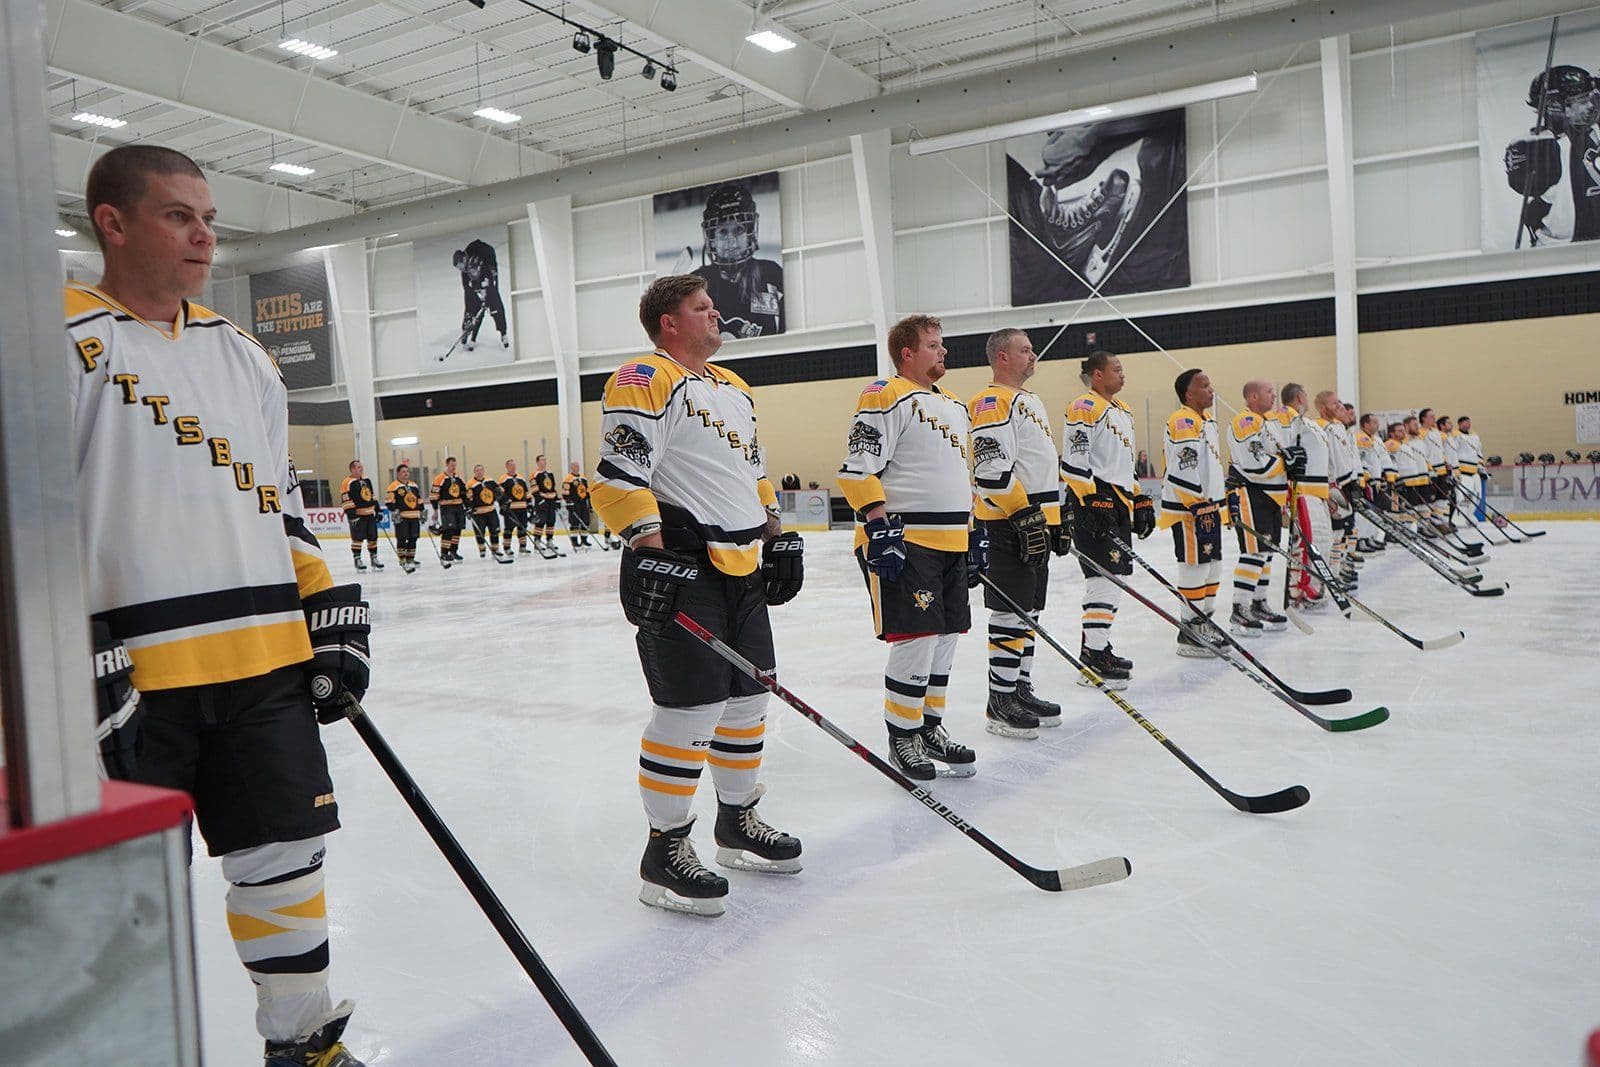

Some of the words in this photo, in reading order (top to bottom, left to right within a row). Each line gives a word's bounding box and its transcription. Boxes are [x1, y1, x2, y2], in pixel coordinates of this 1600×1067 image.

[256, 292, 302, 321] KIDS
[303, 300, 323, 314] ARE
[257, 321, 275, 333] THE
[275, 313, 324, 334] FUTURE
[1565, 391, 1600, 405] HOM
[76, 336, 282, 513] PTTSBUR
[307, 512, 345, 524] TORY
[872, 529, 904, 540] CC
[311, 606, 370, 632] WAR
[911, 787, 972, 833] BAUER
